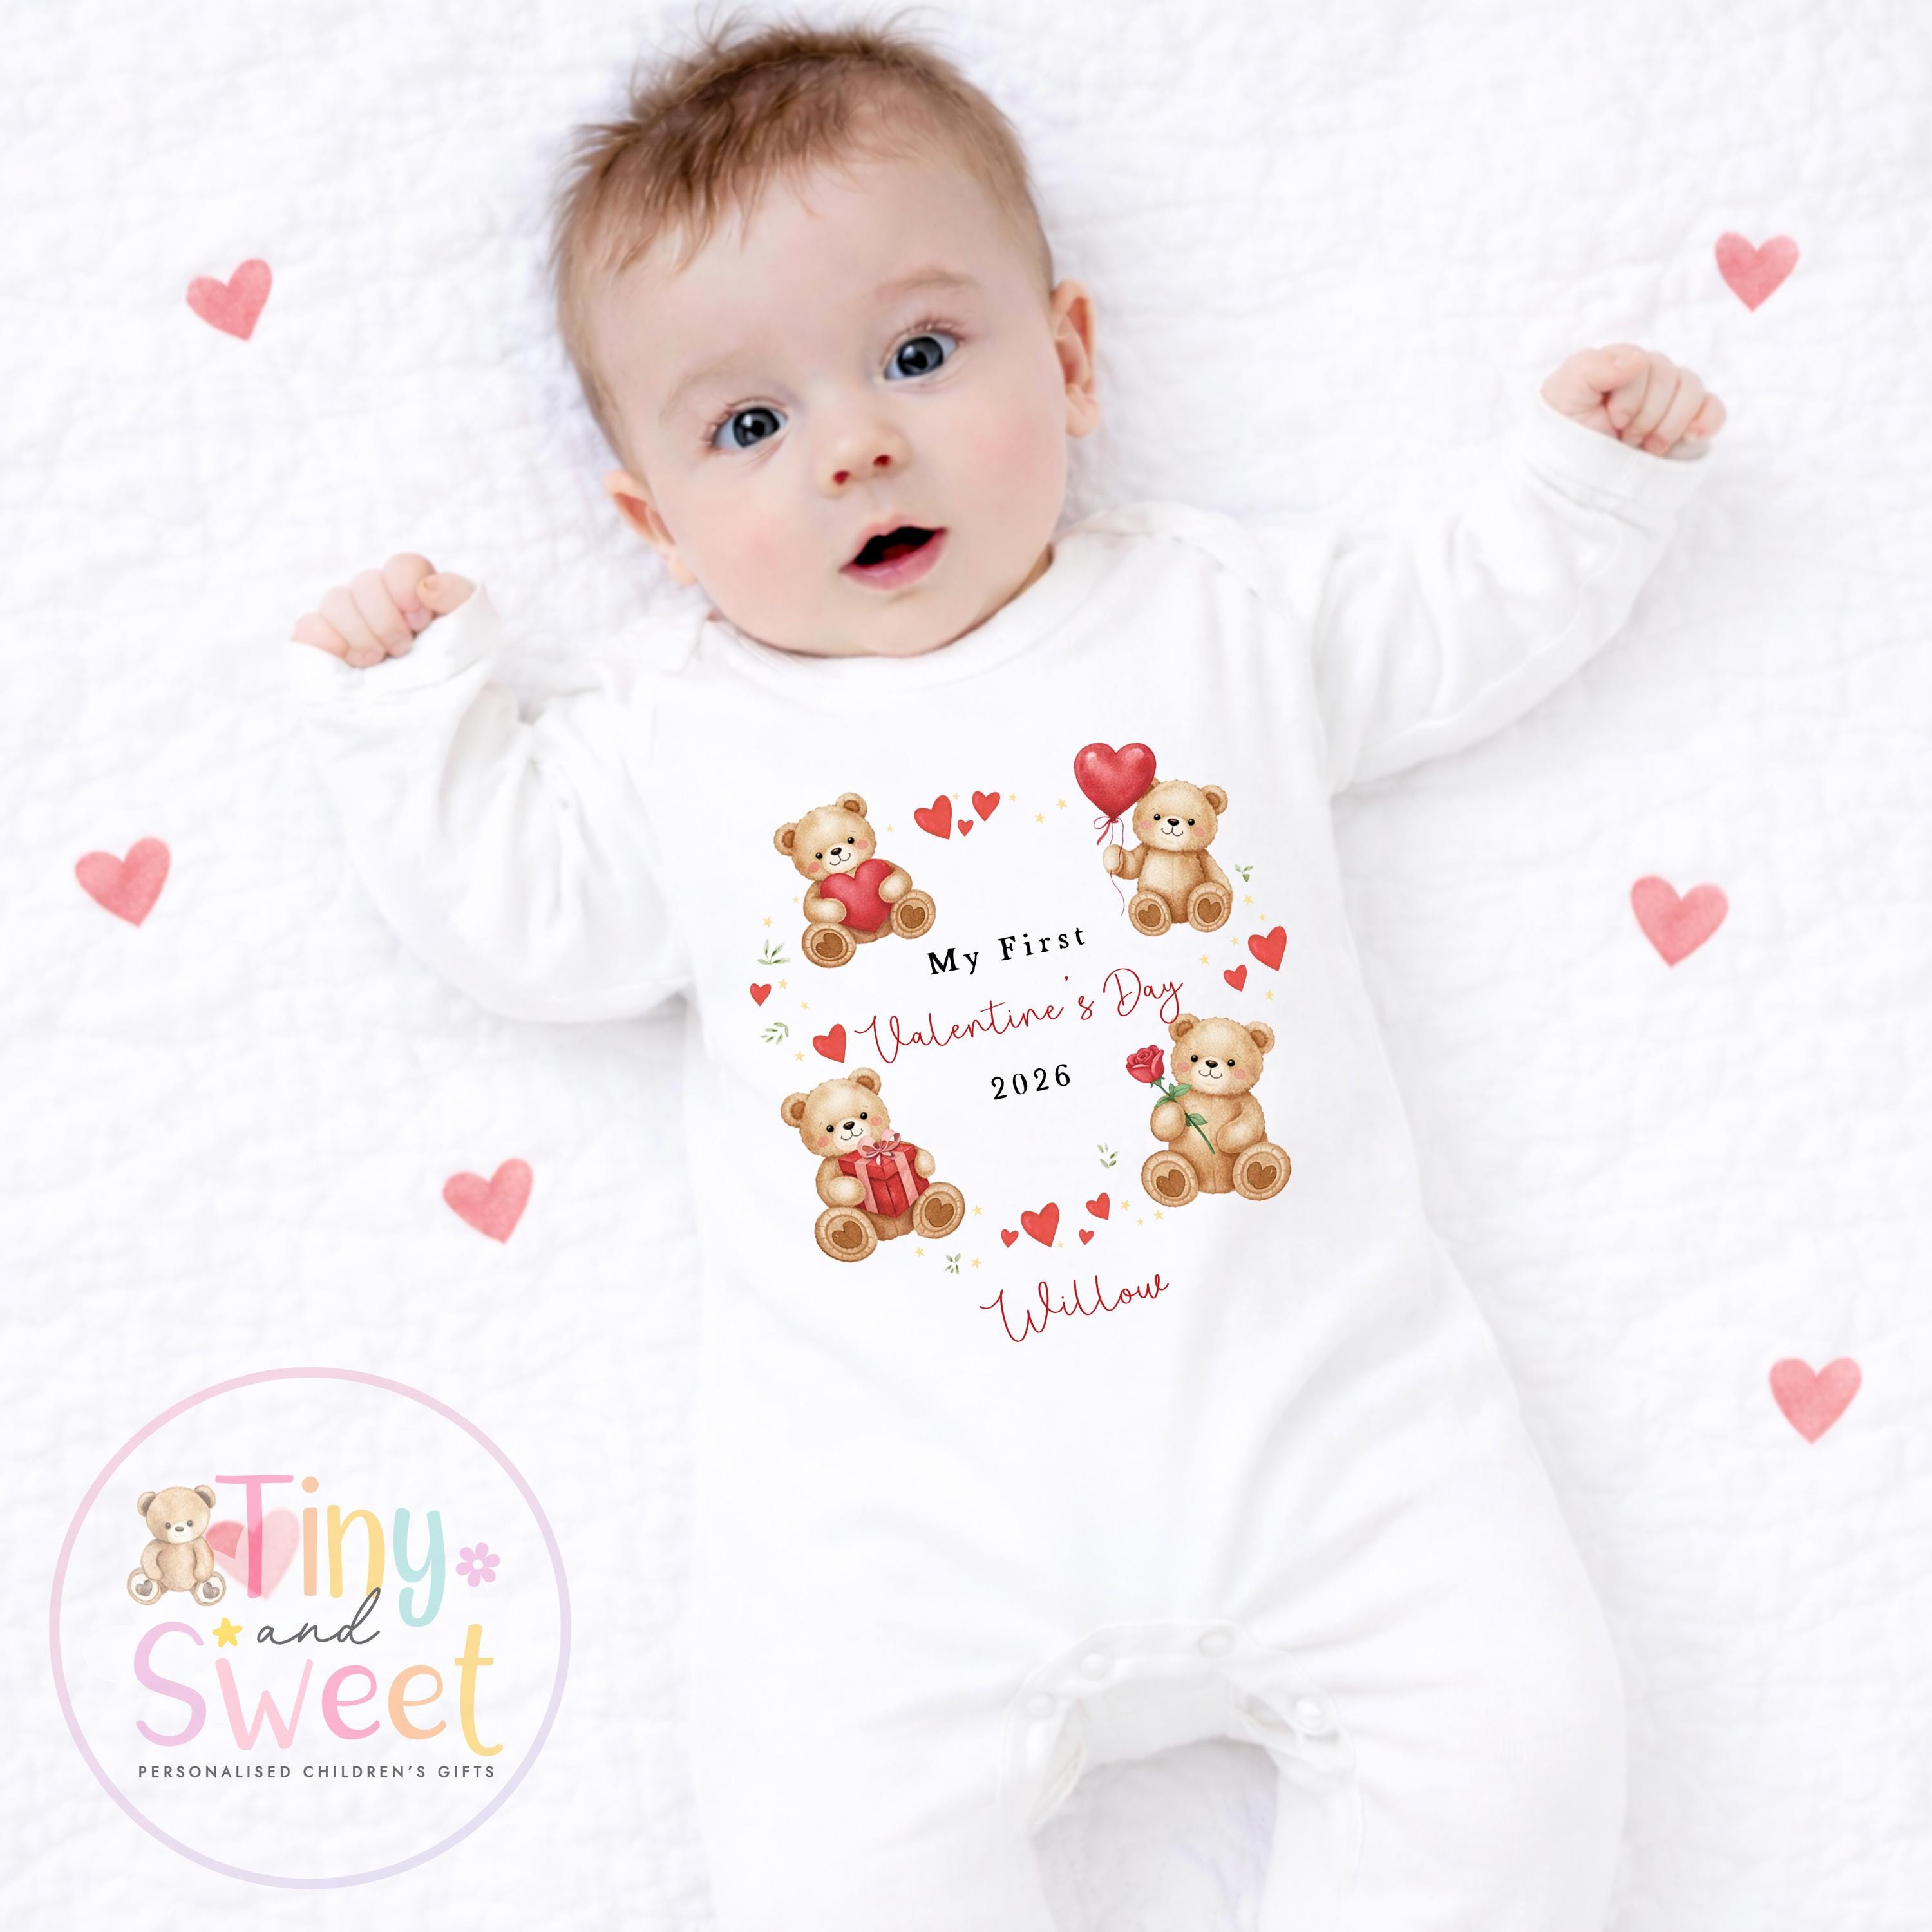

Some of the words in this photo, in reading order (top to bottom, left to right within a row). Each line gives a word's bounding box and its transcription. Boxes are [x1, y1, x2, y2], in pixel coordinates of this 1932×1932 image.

[927, 947, 980, 976] My
[998, 927, 1086, 961] First
[853, 974, 1095, 1064] Valentine's
[1103, 967, 1184, 1025] Day
[990, 1063, 1072, 1101] 2026
[978, 1273, 1170, 1343] Willow
